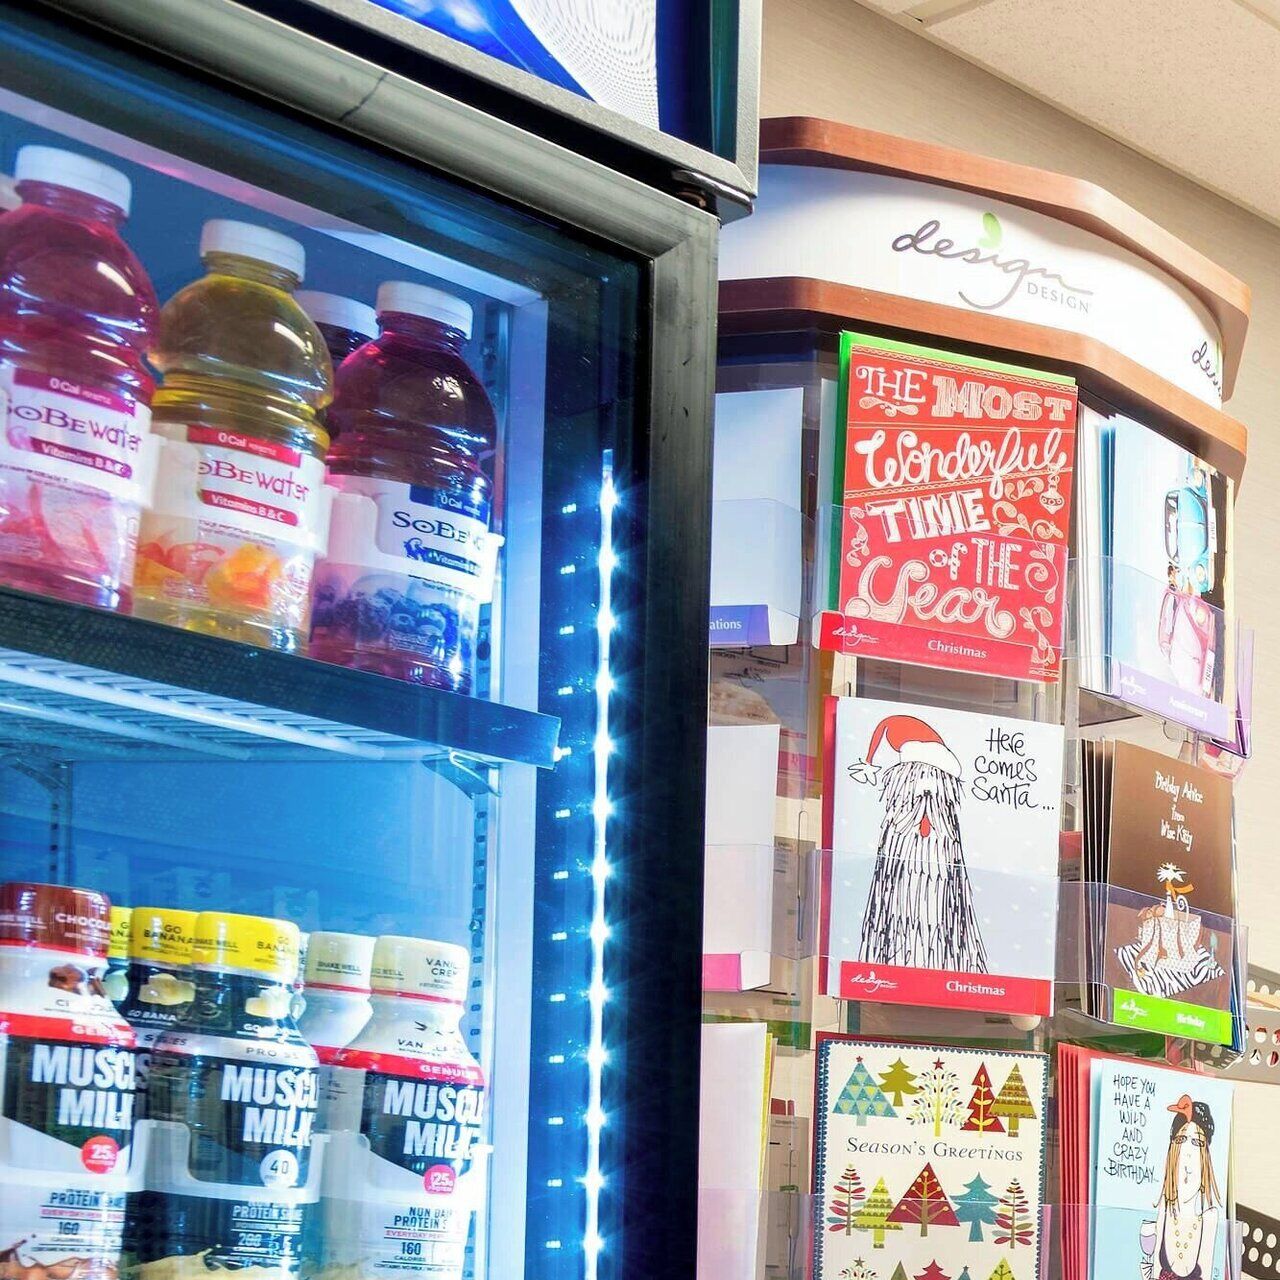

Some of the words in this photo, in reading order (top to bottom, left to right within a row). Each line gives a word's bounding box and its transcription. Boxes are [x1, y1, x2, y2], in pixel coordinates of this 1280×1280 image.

[892, 219, 1094, 310] design
[1027, 281, 1088, 314] DESIGN
[855, 366, 927, 402] THE
[931, 376, 1072, 421] MOST
[854, 427, 1068, 499] Wonderful
[865, 488, 991, 543] TIME
[929, 541, 967, 581] of
[972, 537, 1021, 590] THE
[846, 555, 1016, 638] Year
[928, 639, 987, 659] Christmas
[986, 727, 1025, 757] Here
[975, 756, 1038, 781] comes
[1154, 770, 1180, 799] Birthday
[1172, 806, 1185, 822] from
[945, 981, 1006, 997] Christmas
[1176, 1012, 1206, 1029] Birthday
[1113, 1074, 1138, 1090] HOPE
[1140, 1077, 1156, 1097] YOU
[1114, 1093, 1140, 1108] HAVE
[1143, 1096, 1151, 1111] A
[1119, 1110, 1147, 1127] WILD
[1121, 1128, 1144, 1142] AND
[1114, 1143, 1149, 1163] CRAZY
[58, 1221, 79, 1235] 160
[401, 1242, 422, 1256] 160
